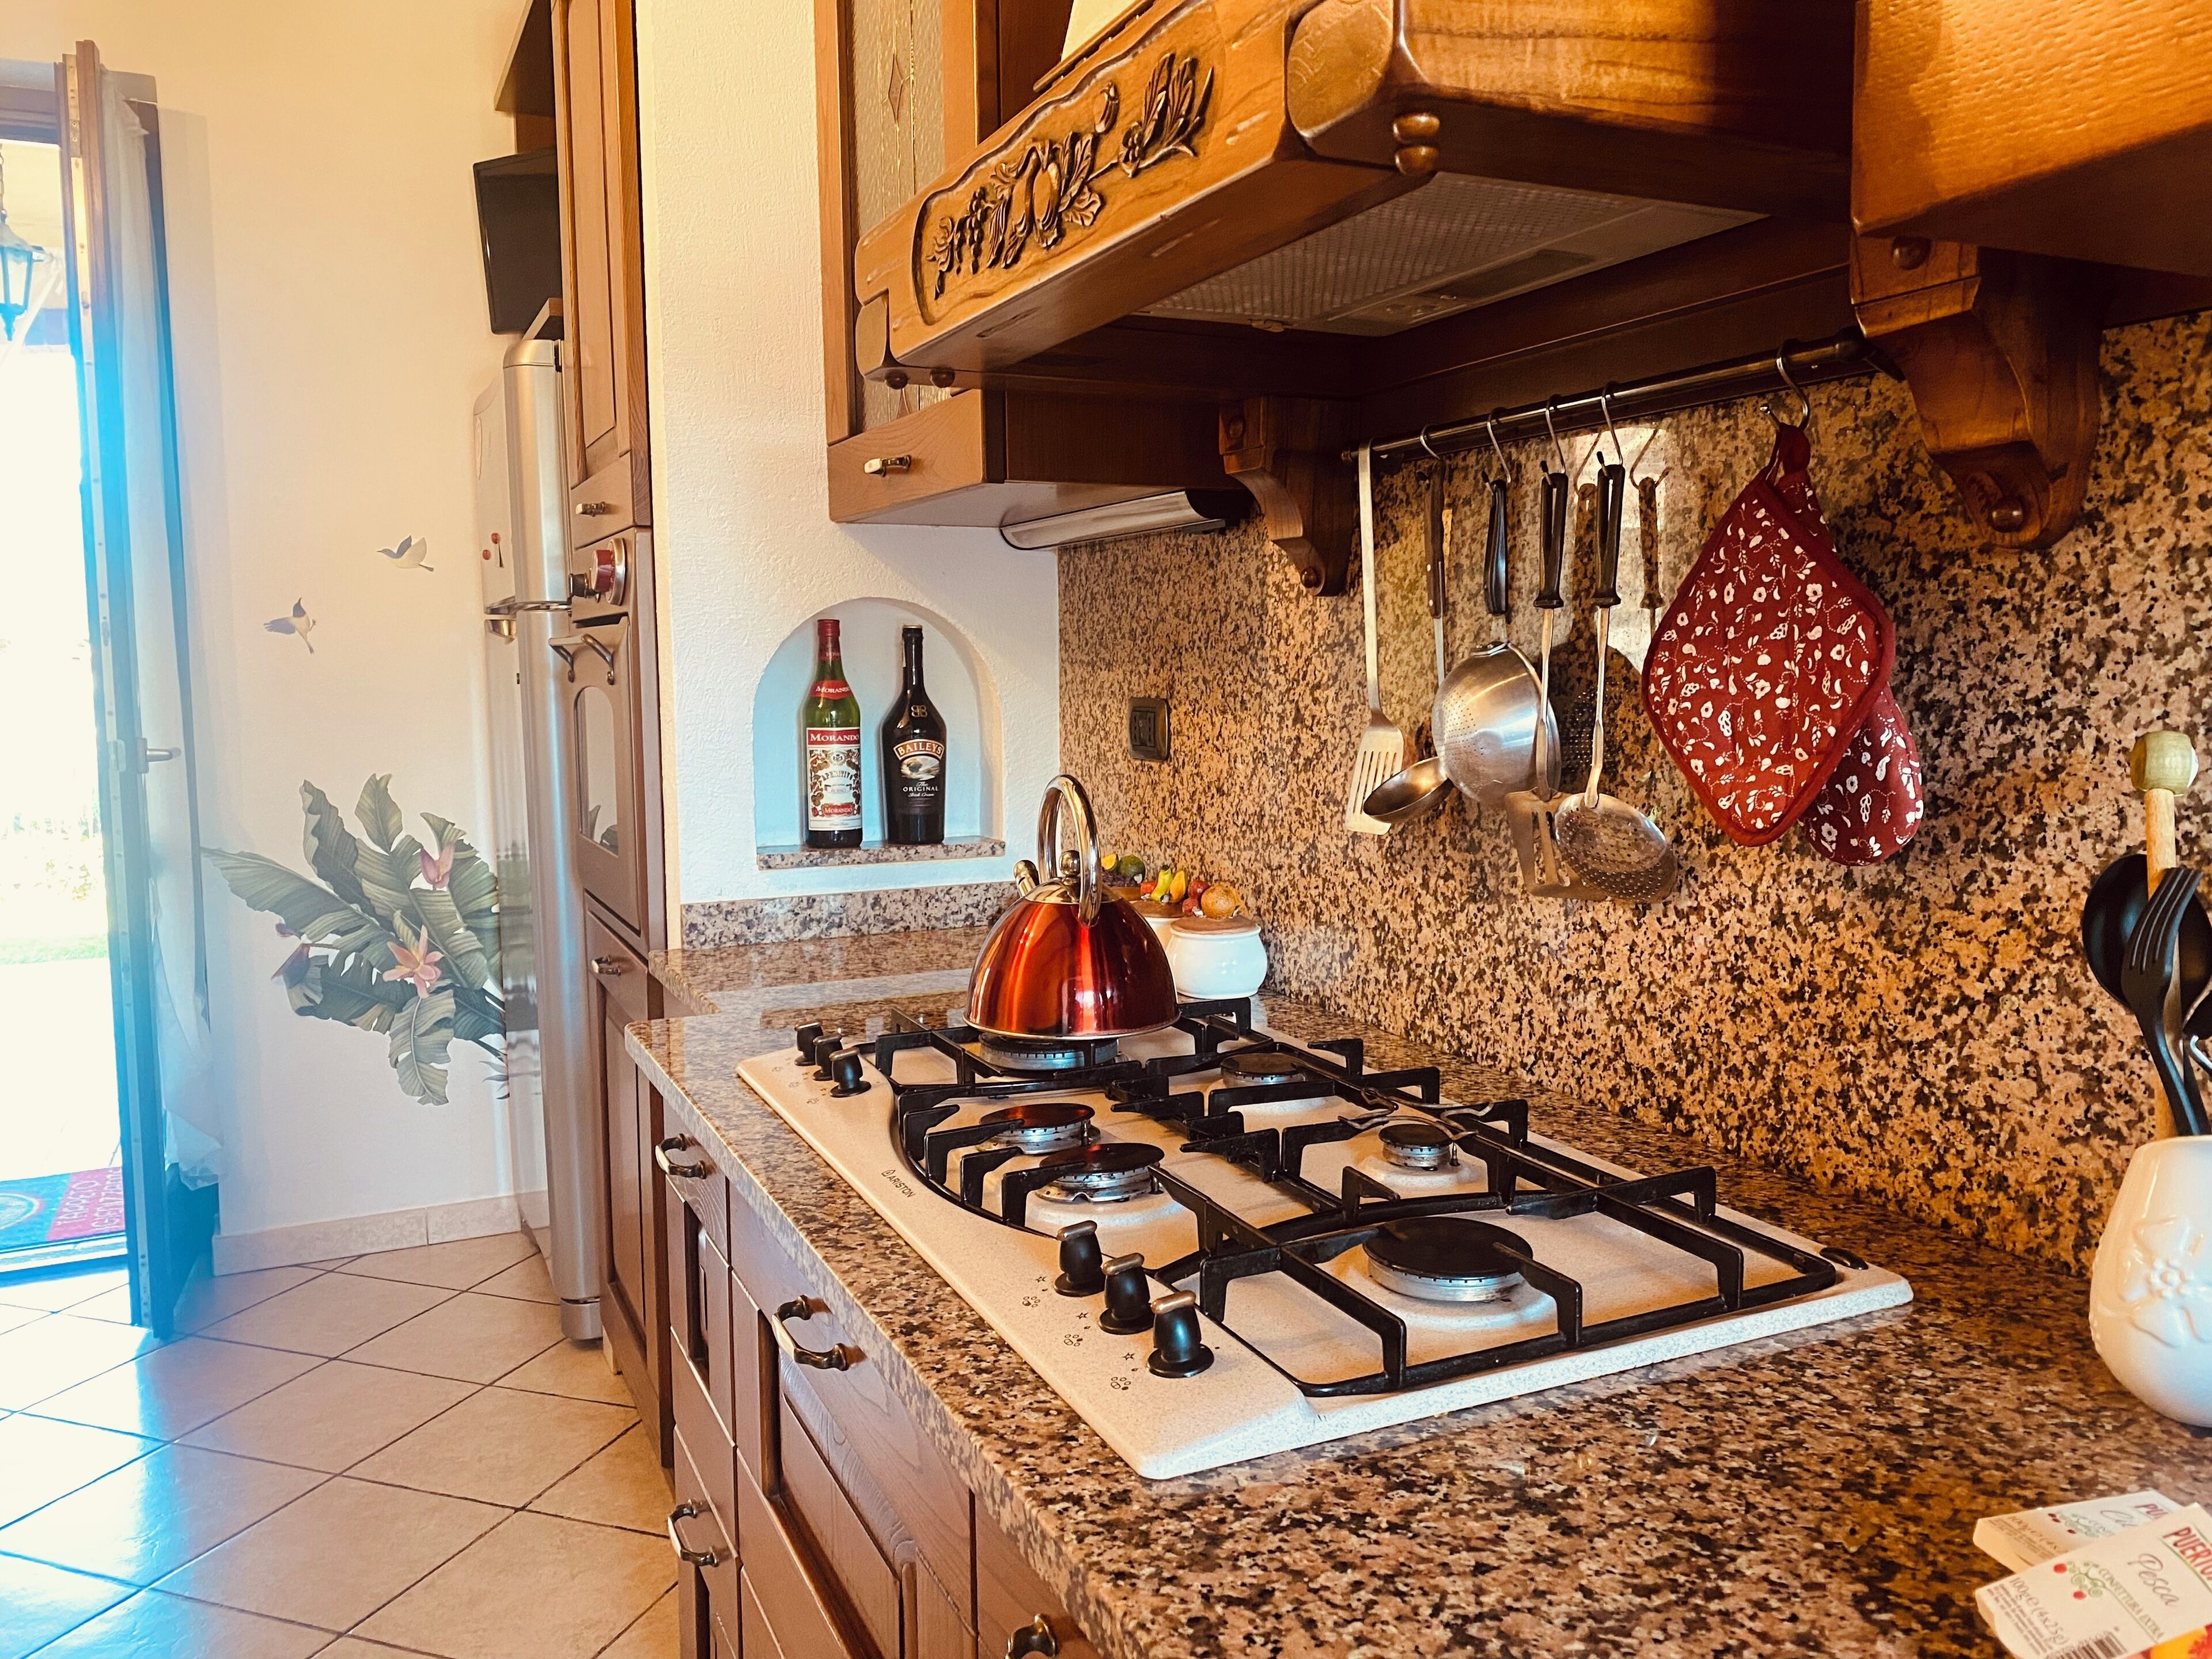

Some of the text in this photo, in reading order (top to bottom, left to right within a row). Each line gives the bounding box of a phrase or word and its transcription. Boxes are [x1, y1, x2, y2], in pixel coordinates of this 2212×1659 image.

[810, 733, 859, 742] MORANDO
[897, 740, 942, 756] BAILEYS
[887, 1175, 916, 1198] ARISTON
[2127, 1552, 2180, 1606] Pesca
